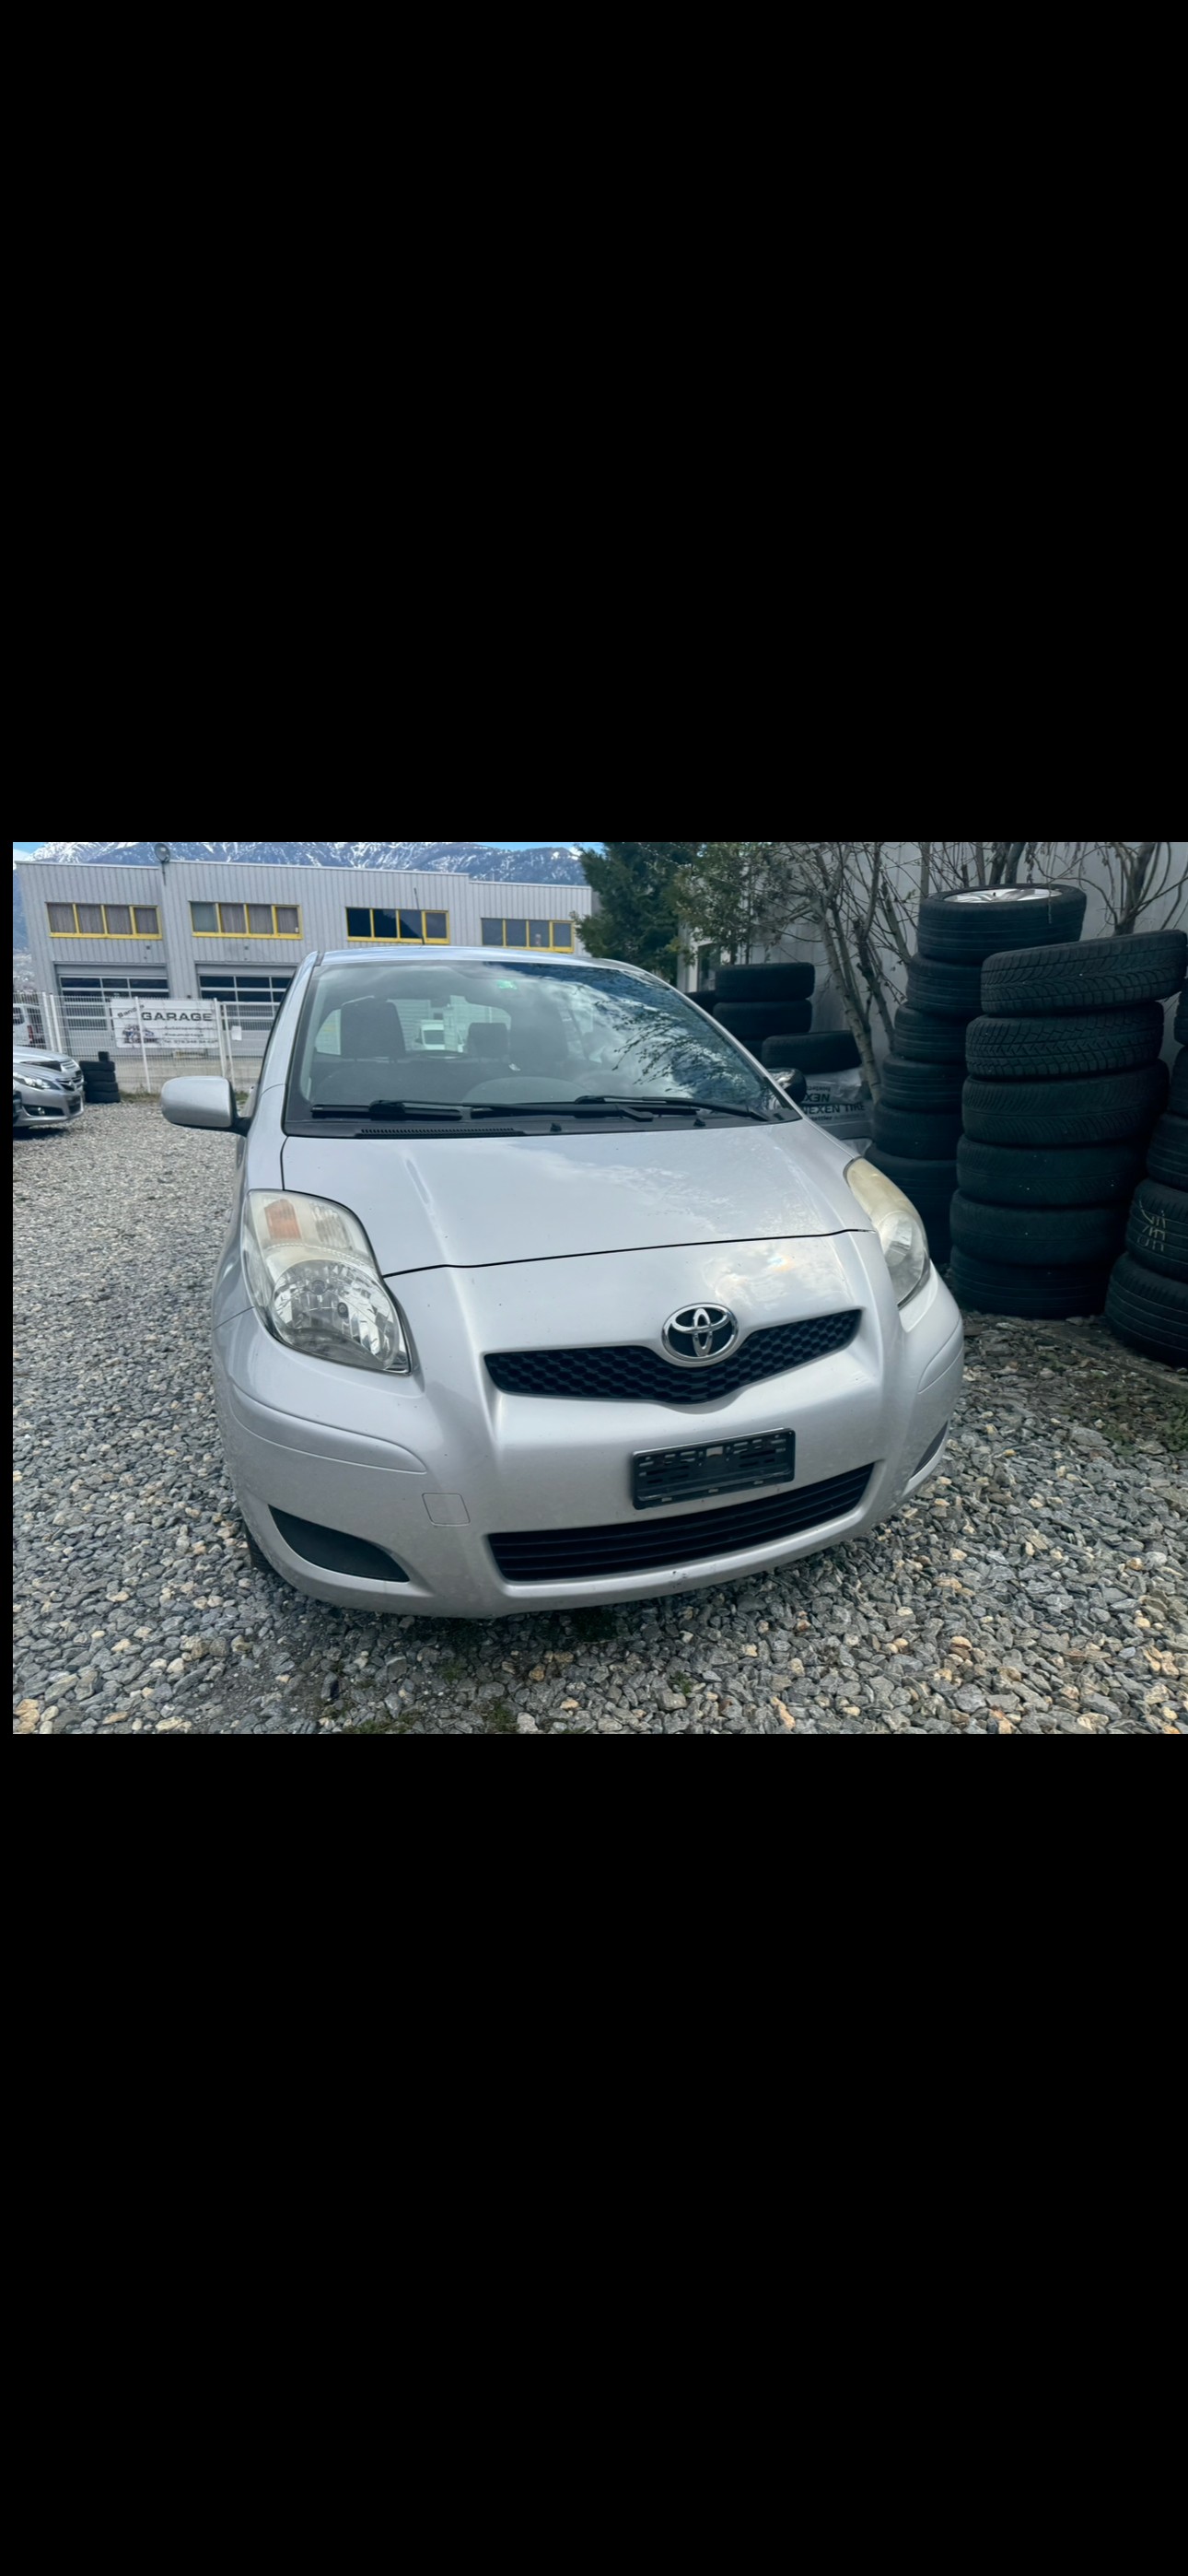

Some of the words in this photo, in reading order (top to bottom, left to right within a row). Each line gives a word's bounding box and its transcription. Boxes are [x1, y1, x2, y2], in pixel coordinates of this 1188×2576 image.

[141, 1013, 213, 1022] GARAGE
[802, 1105, 840, 1114] NEXEN
[844, 1102, 865, 1111] TIRE
